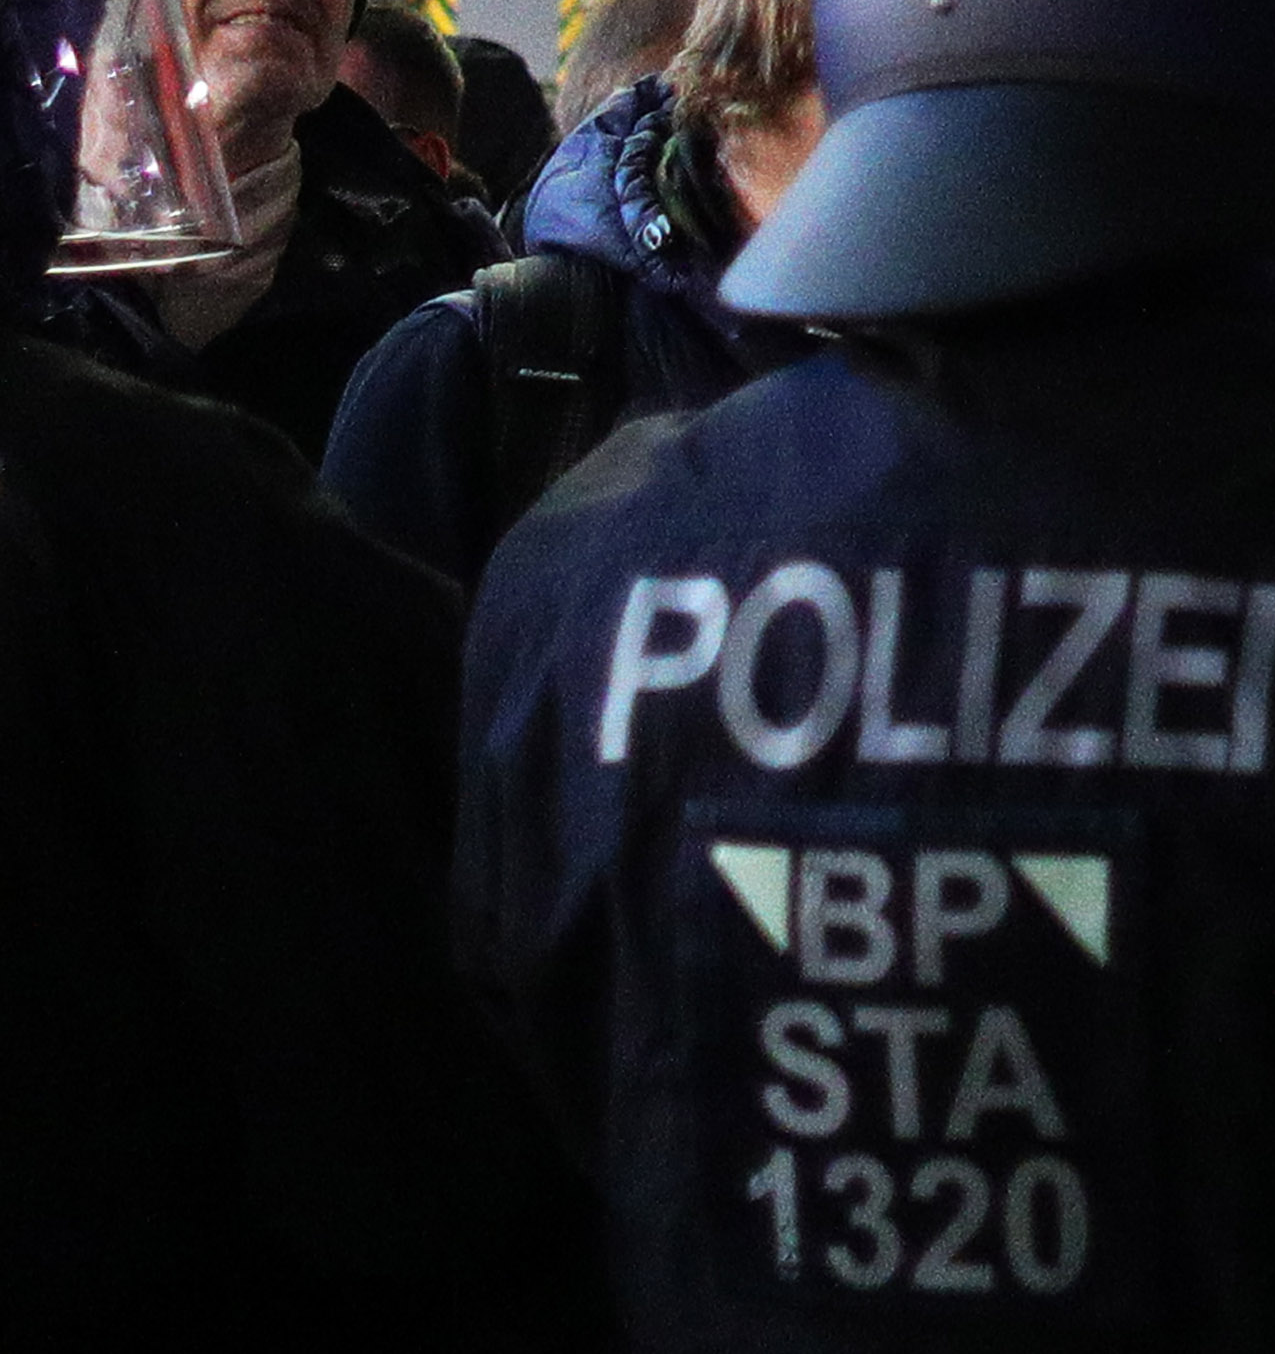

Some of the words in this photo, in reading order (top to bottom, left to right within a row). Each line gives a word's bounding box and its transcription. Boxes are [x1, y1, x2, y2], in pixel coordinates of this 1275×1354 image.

[799, 848, 1012, 988] BP
[757, 999, 1068, 1143] STA
[746, 1147, 1091, 1296] 1320
